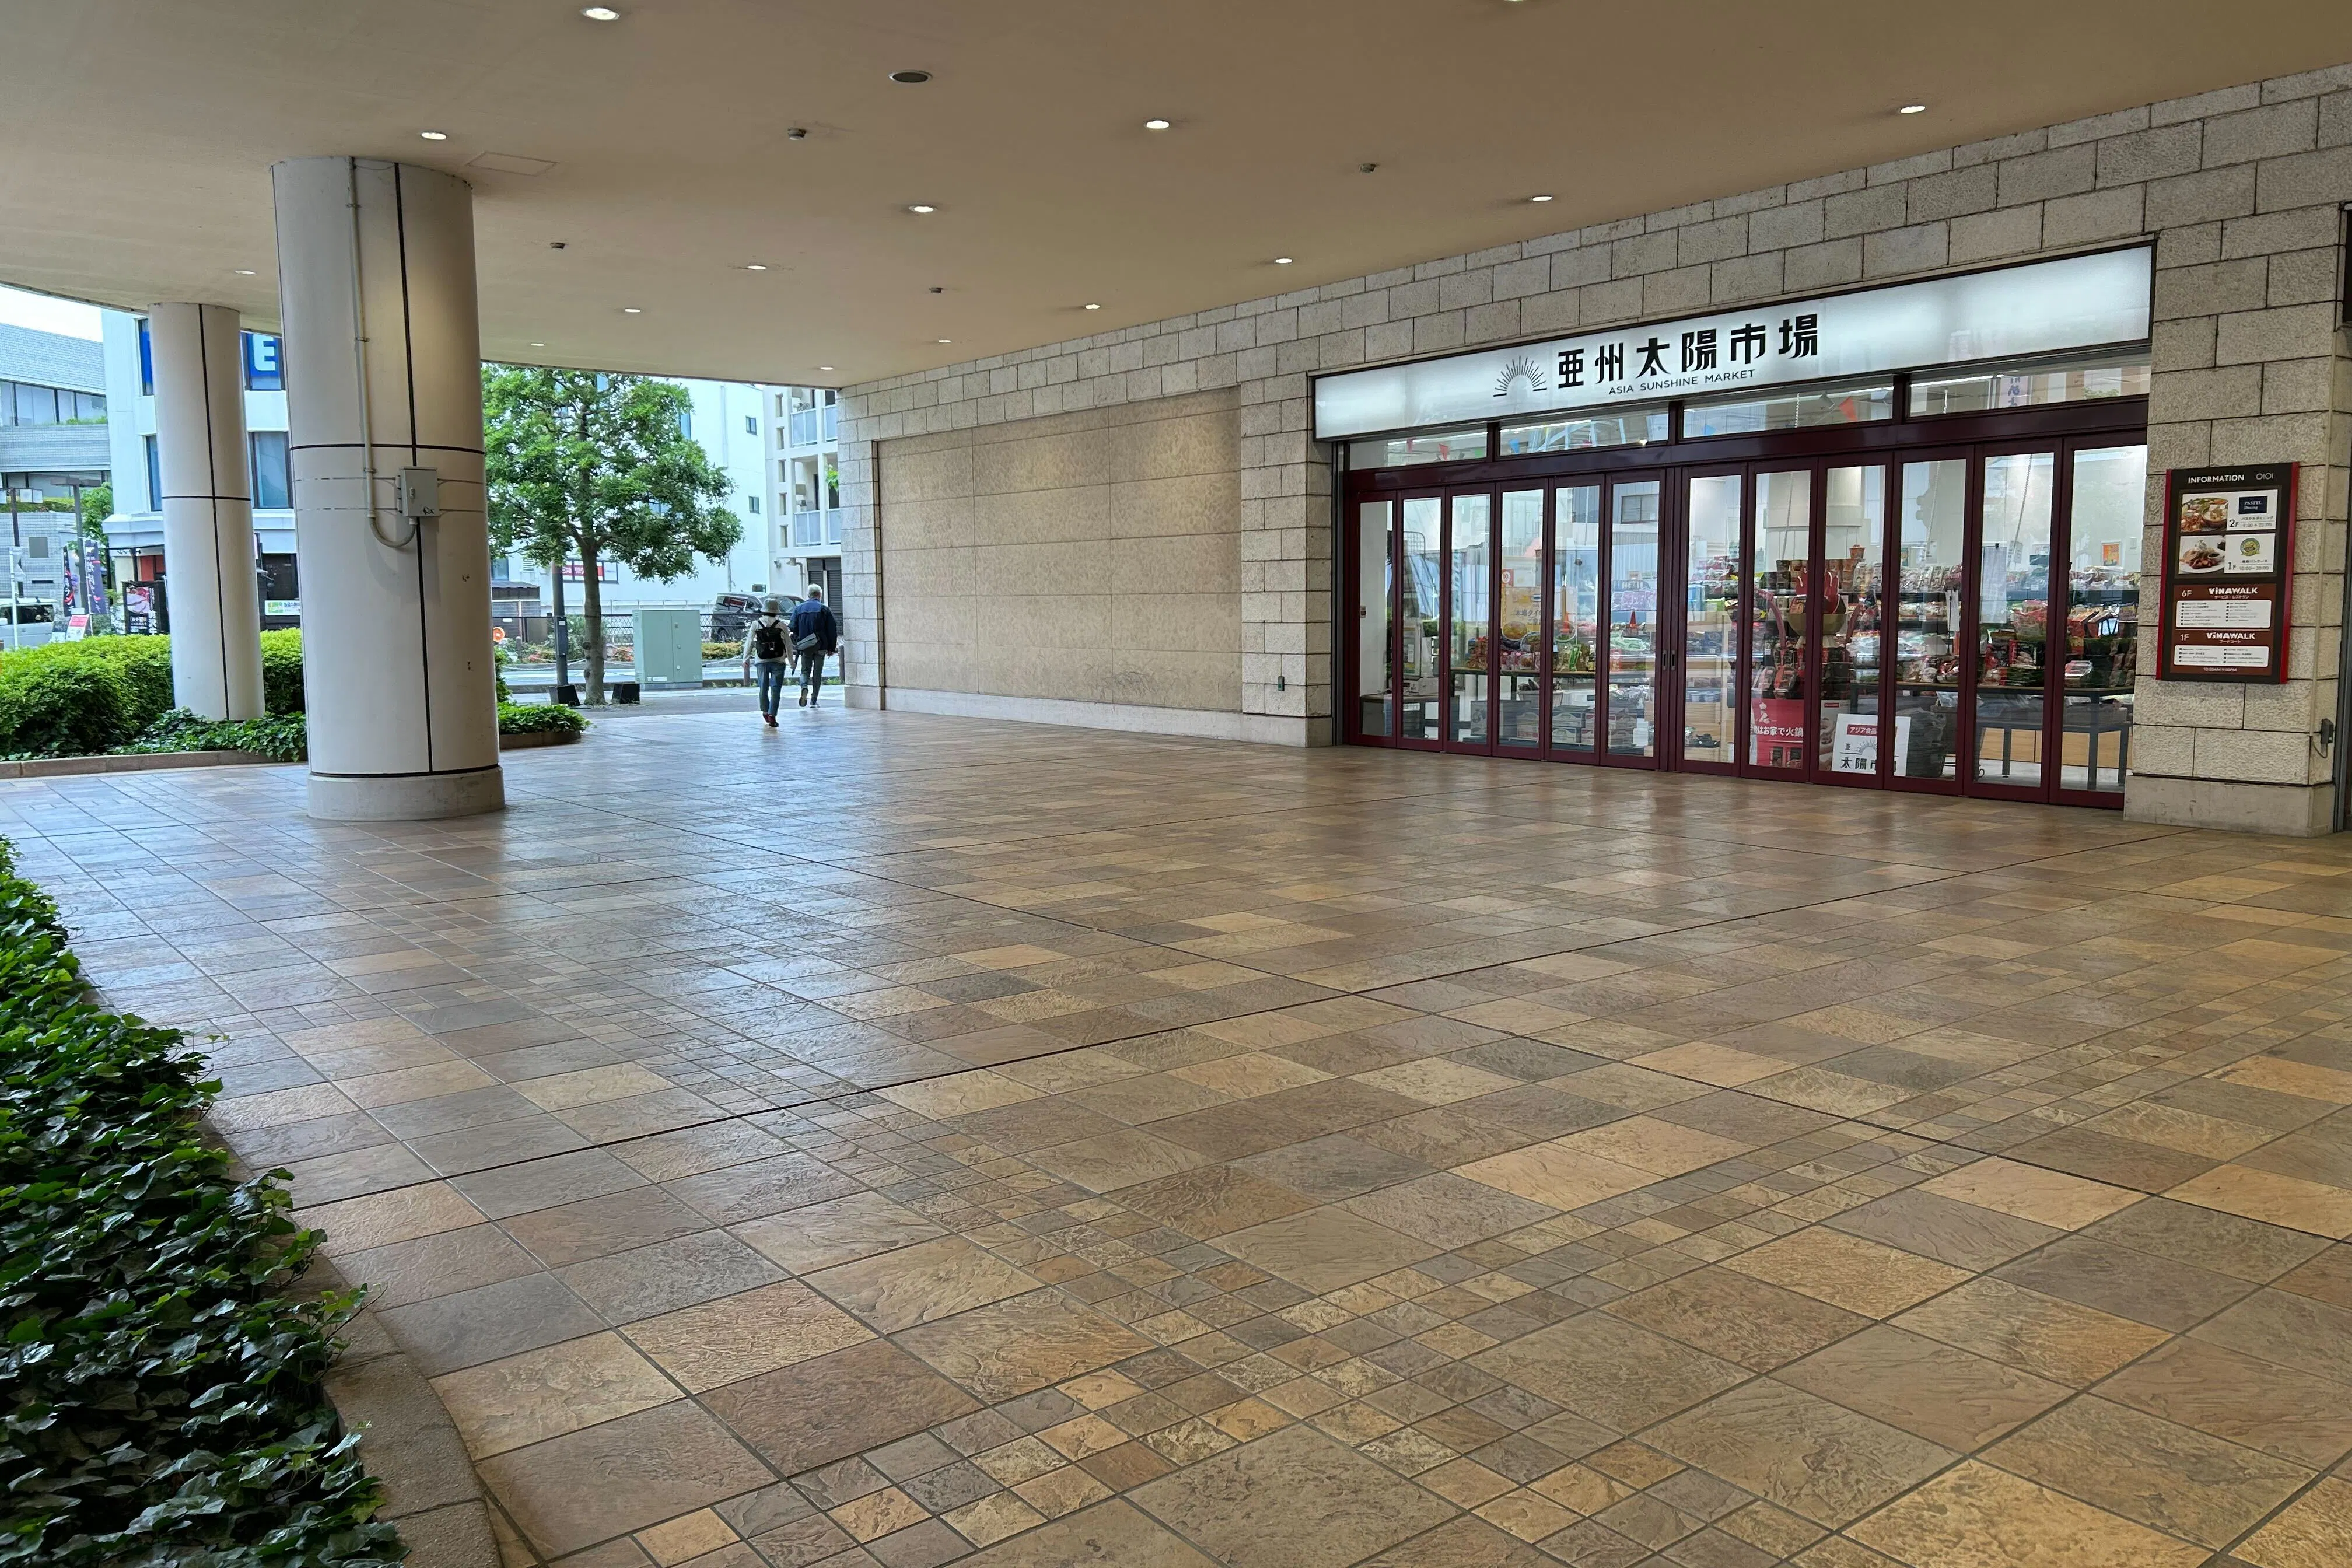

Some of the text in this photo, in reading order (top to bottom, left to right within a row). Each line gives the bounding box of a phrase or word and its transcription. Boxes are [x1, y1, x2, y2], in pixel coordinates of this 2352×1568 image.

[1558, 313, 1818, 389] 亜州太陽市場
[1608, 369, 1755, 395] ASIA SUNSHINE MARKET
[2188, 474, 2245, 484] INFORMATION
[2229, 519, 2239, 527] 2F
[2228, 562, 2236, 570] 1F
